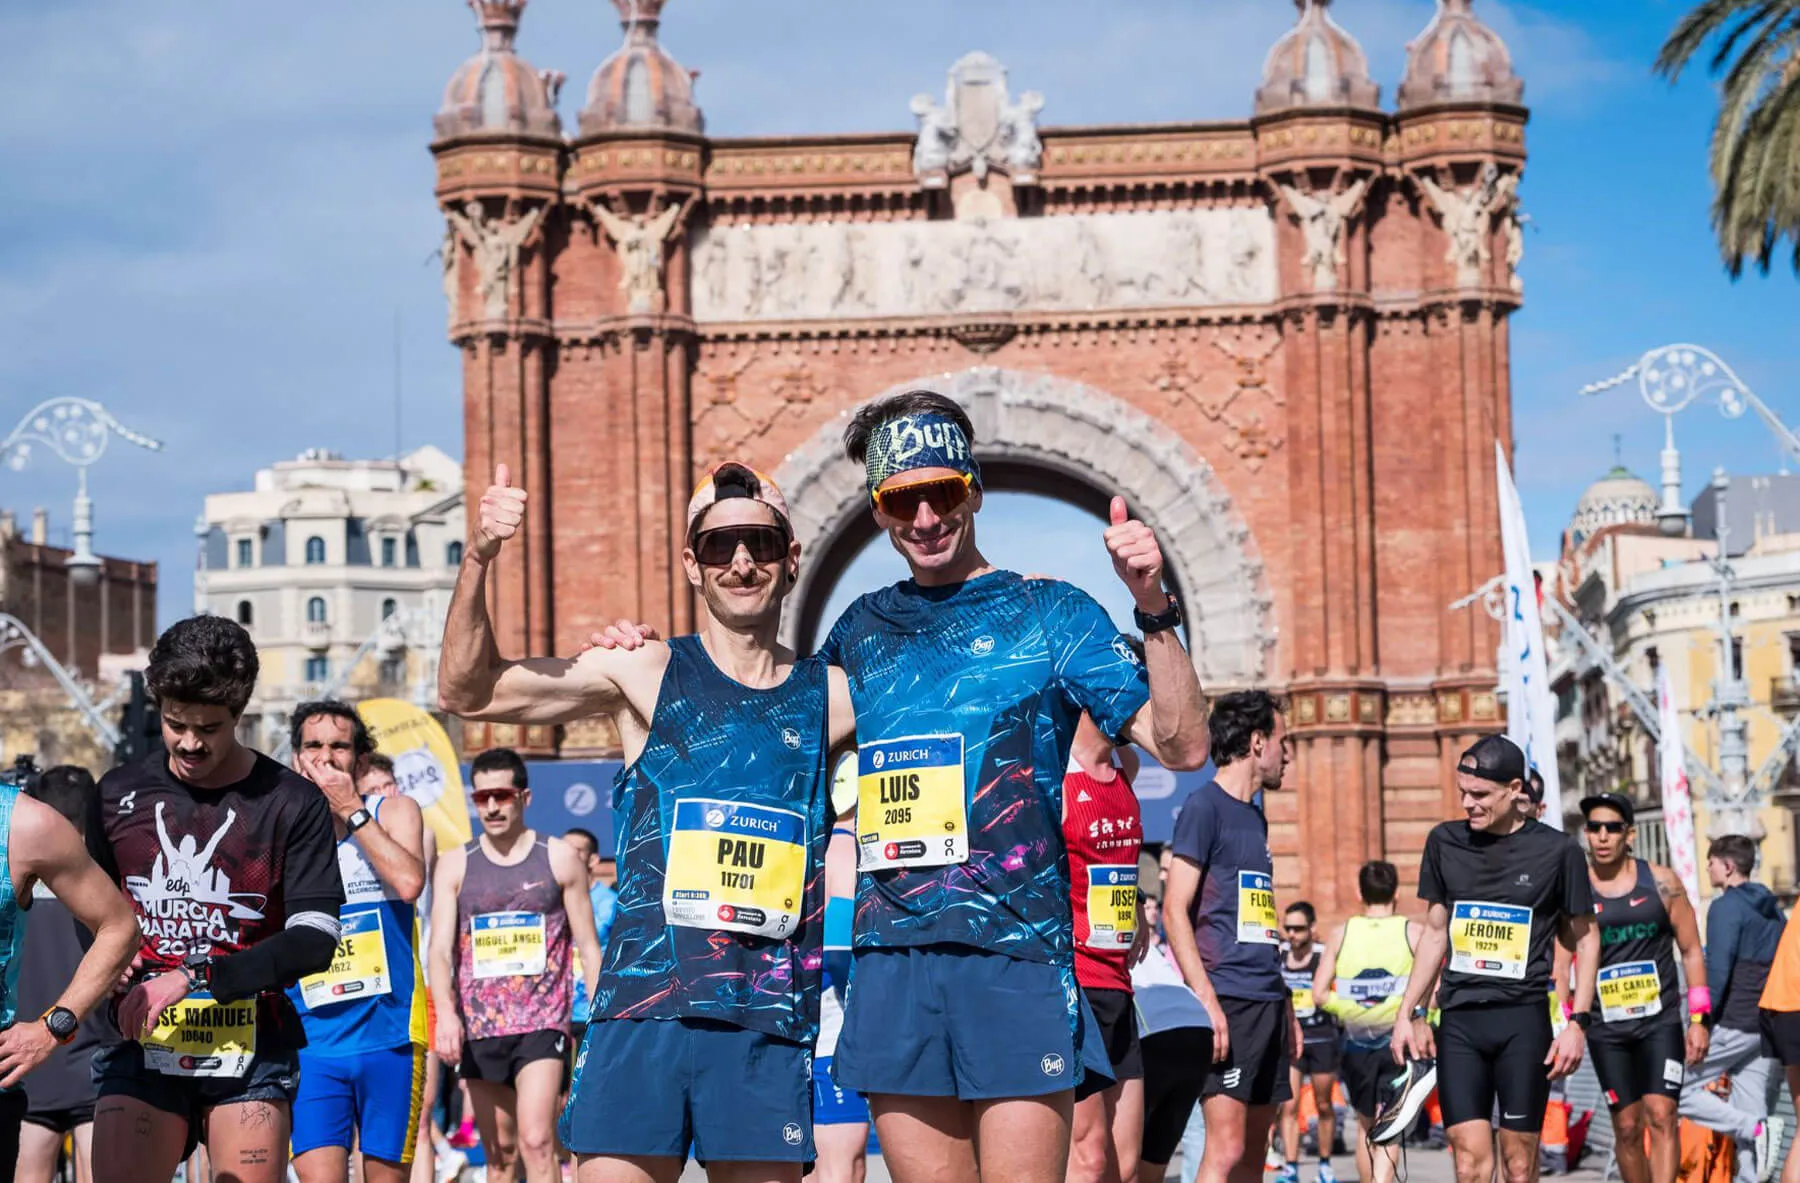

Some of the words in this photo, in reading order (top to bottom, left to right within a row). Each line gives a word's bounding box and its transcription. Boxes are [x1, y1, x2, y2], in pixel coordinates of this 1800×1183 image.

[886, 416, 965, 463] Buff
[784, 731, 799, 747] Buff
[887, 748, 930, 763] ZURICH
[880, 773, 920, 804] LUIS
[729, 814, 778, 833] ZURICH
[884, 807, 912, 825] 2095
[716, 838, 765, 869] PAU
[165, 876, 191, 896] edp
[720, 870, 755, 890] 11701
[143, 899, 227, 929] MURCIA
[156, 937, 213, 956] 2019
[184, 1006, 255, 1028] MANUEL
[1043, 1058, 1063, 1073] Buff
[784, 1126, 801, 1142] Buff
